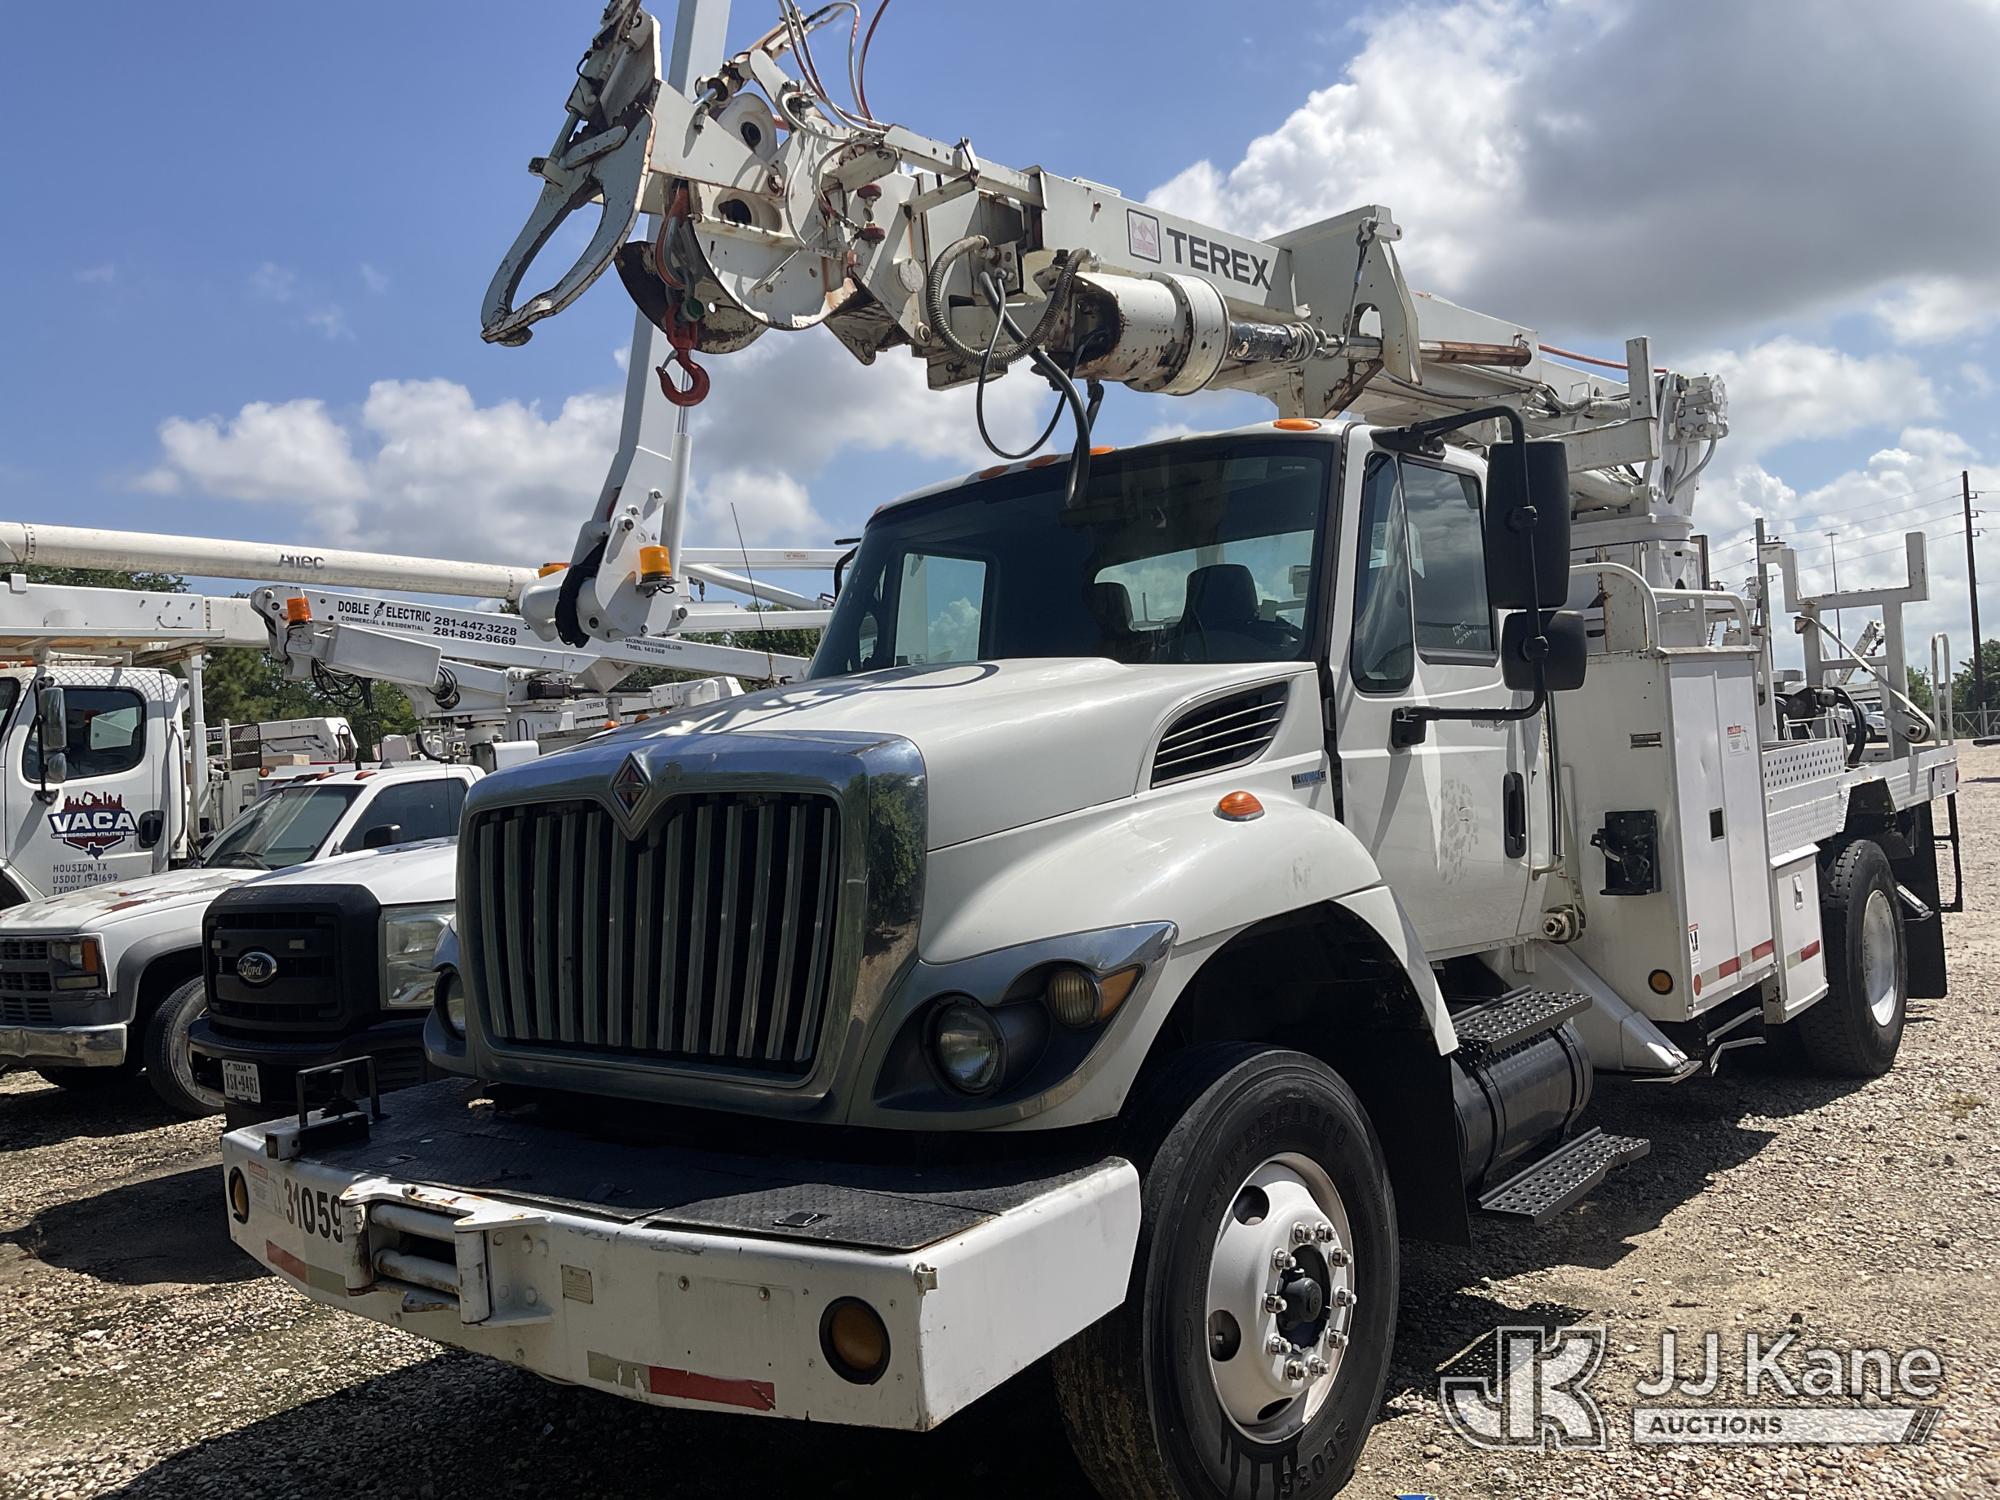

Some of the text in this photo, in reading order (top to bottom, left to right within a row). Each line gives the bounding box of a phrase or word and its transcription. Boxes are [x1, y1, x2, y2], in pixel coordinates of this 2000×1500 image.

[1166, 227, 1272, 291] TEREX
[338, 601, 370, 615] DOBLE
[386, 606, 431, 622] ELECTRIC
[341, 615, 379, 625] COMMERCIAL
[387, 621, 424, 631] RESIDENTIAL
[434, 616, 517, 636] 281-447-3228
[433, 627, 516, 645] 281-892-9669
[585, 701, 605, 709] TEREX
[52, 812, 135, 833] VACA
[97, 863, 107, 871] TX
[53, 873, 118, 883] USDOT 1941699
[241, 957, 264, 976] Ford
[283, 1177, 344, 1244] 31059
